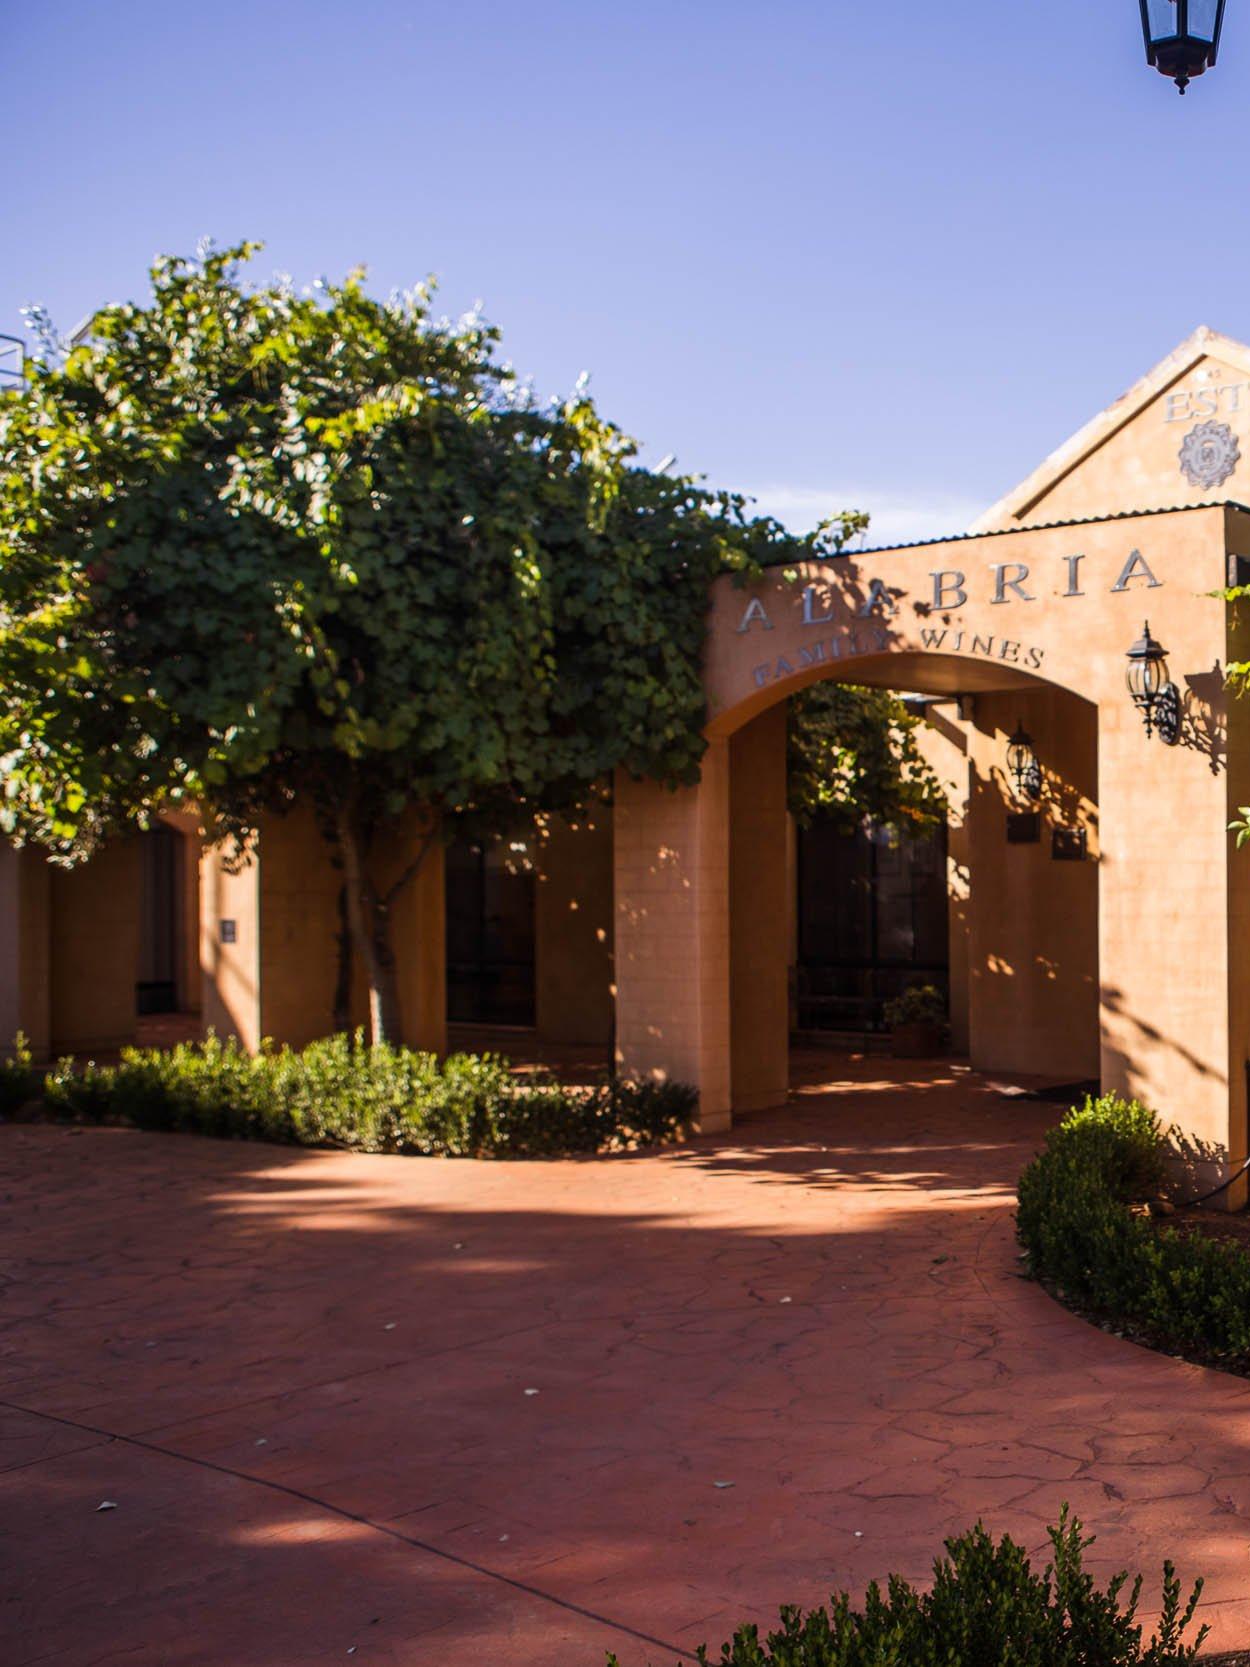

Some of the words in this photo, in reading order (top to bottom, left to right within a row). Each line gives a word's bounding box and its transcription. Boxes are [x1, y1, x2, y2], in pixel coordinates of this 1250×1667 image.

[736, 548, 1163, 633] ALABRIA
[752, 629, 892, 688] FAMILY
[920, 628, 1046, 669] WINES
